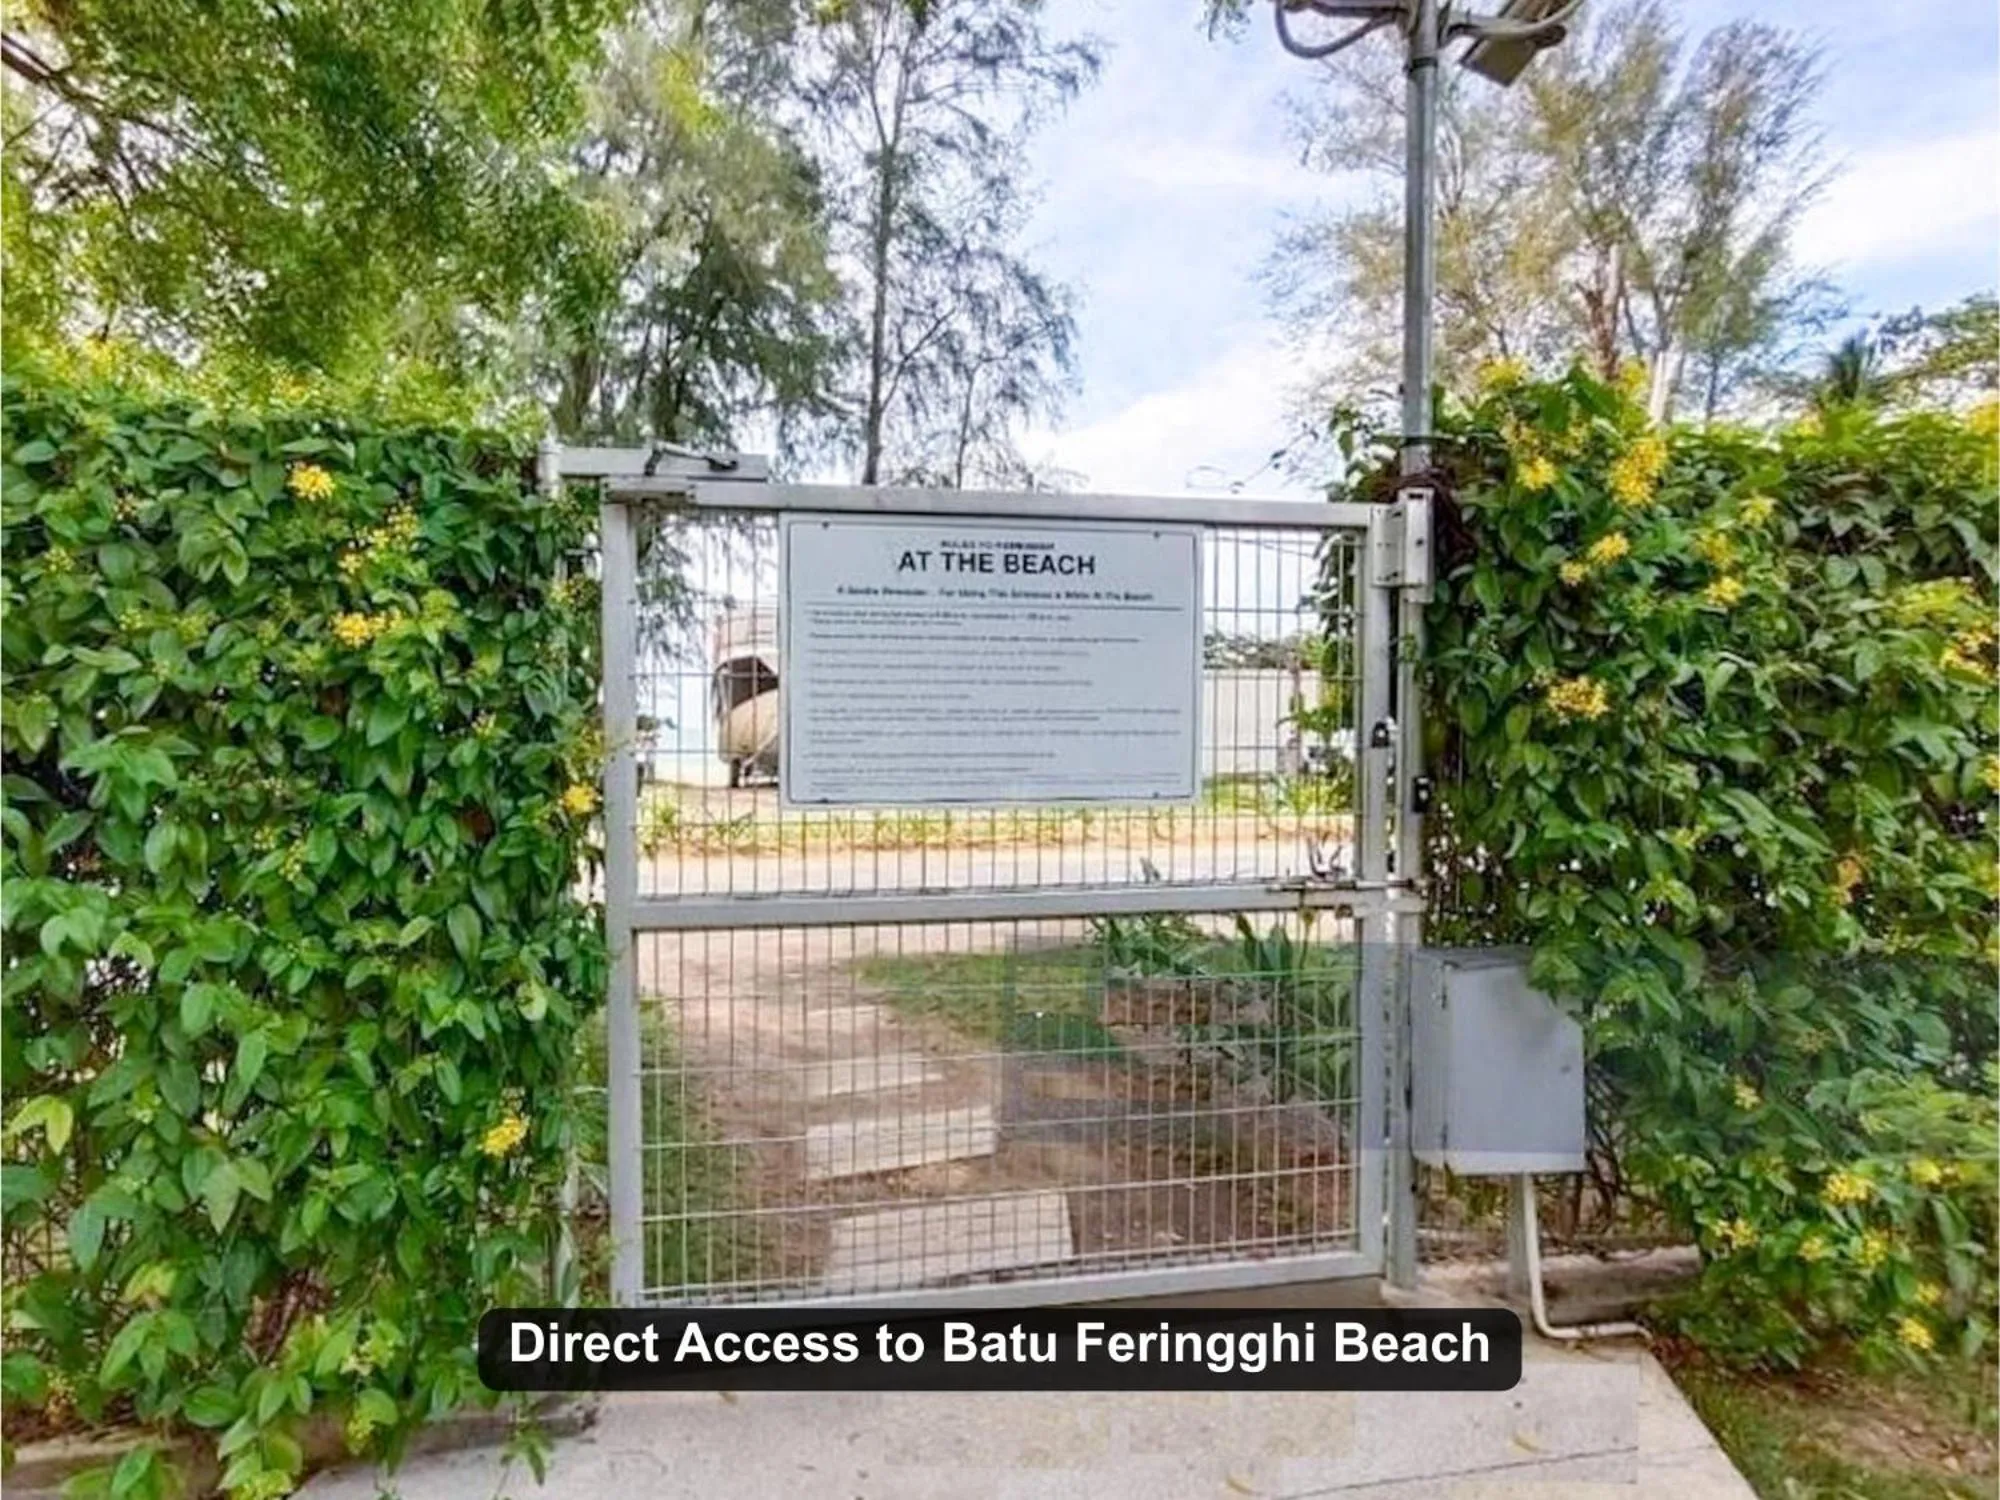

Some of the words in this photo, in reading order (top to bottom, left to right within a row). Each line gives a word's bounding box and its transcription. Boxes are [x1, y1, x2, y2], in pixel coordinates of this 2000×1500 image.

[899, 551, 932, 572] AT
[940, 551, 994, 573] THE
[1003, 553, 1095, 575] BEACH
